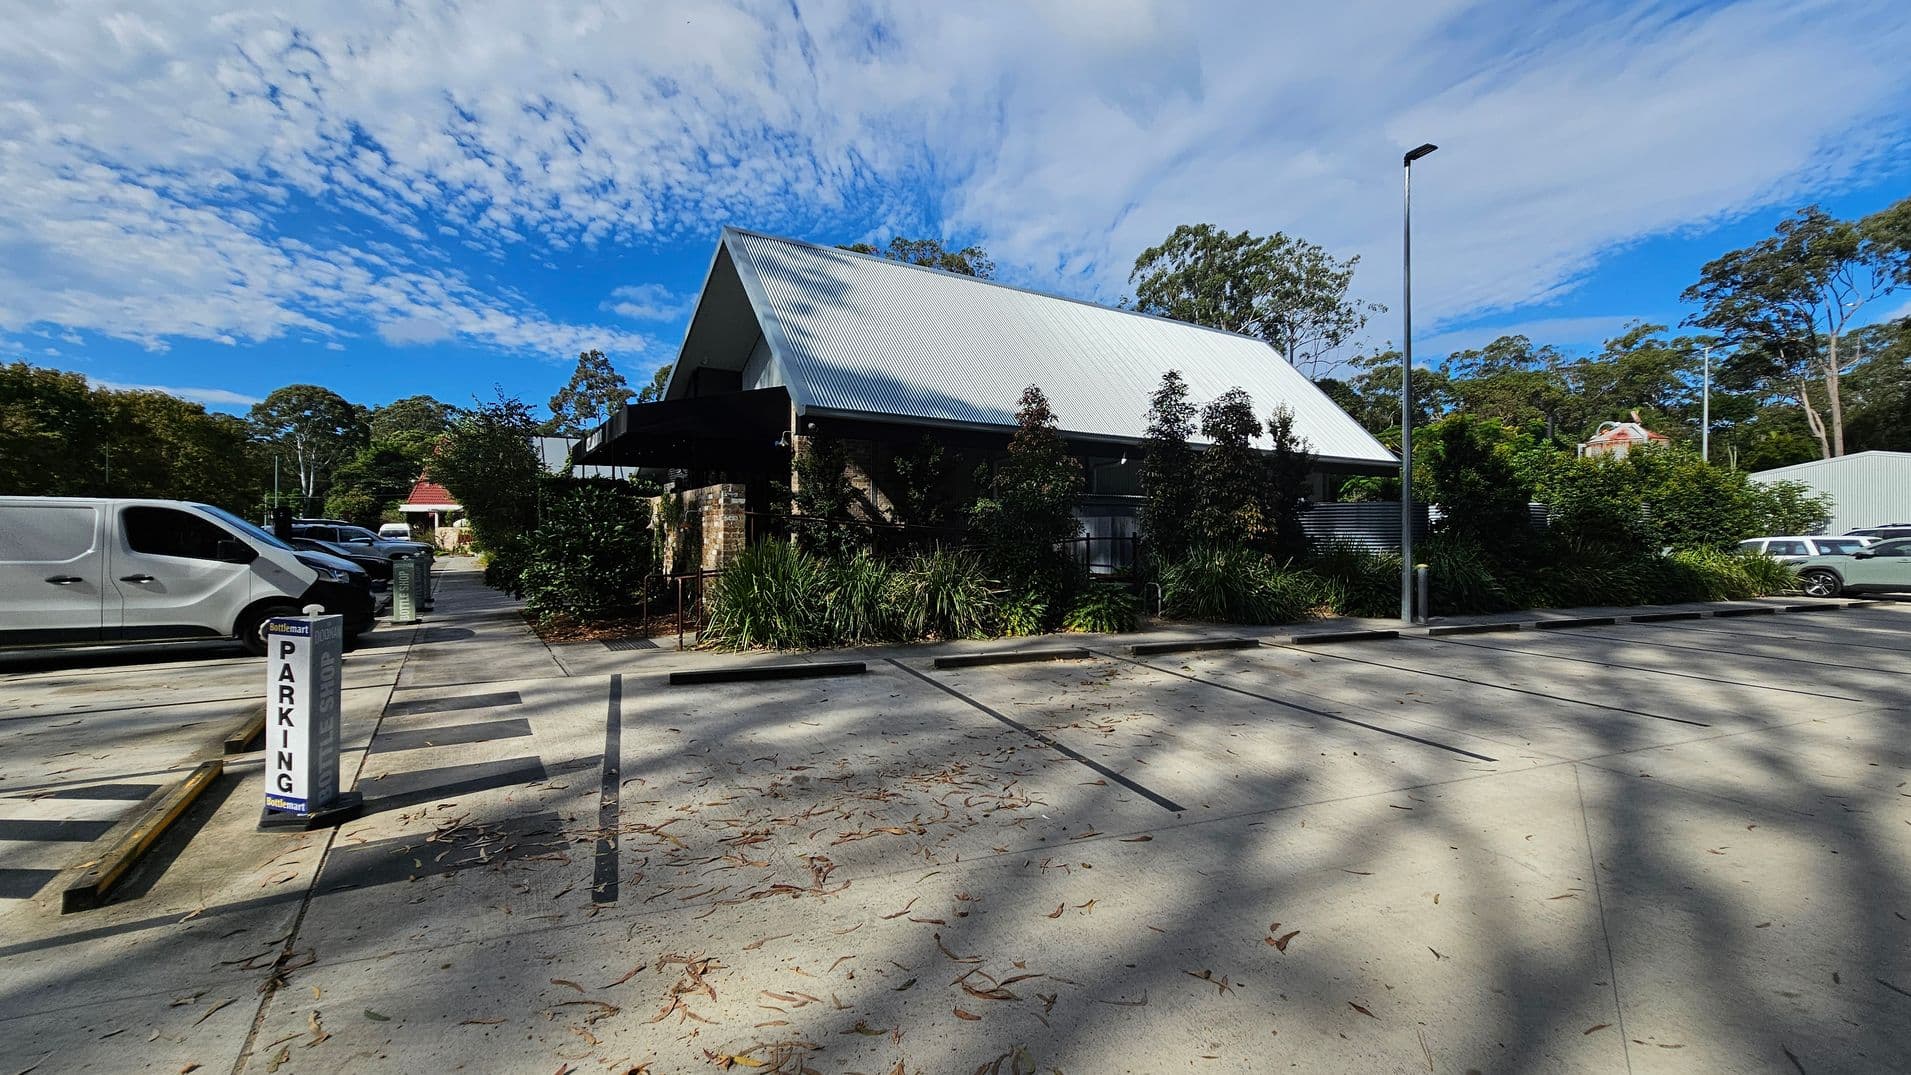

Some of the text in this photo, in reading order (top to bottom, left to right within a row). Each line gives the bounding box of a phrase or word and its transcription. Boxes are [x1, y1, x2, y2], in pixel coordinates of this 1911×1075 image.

[398, 571, 410, 591] SHOP
[399, 593, 410, 621] BOTTLE
[269, 623, 309, 635] Bottlemart
[320, 651, 336, 713] SHOP
[277, 641, 295, 793] PARKING
[319, 717, 335, 804] BOTTLE
[266, 796, 306, 811] Bottlemart
